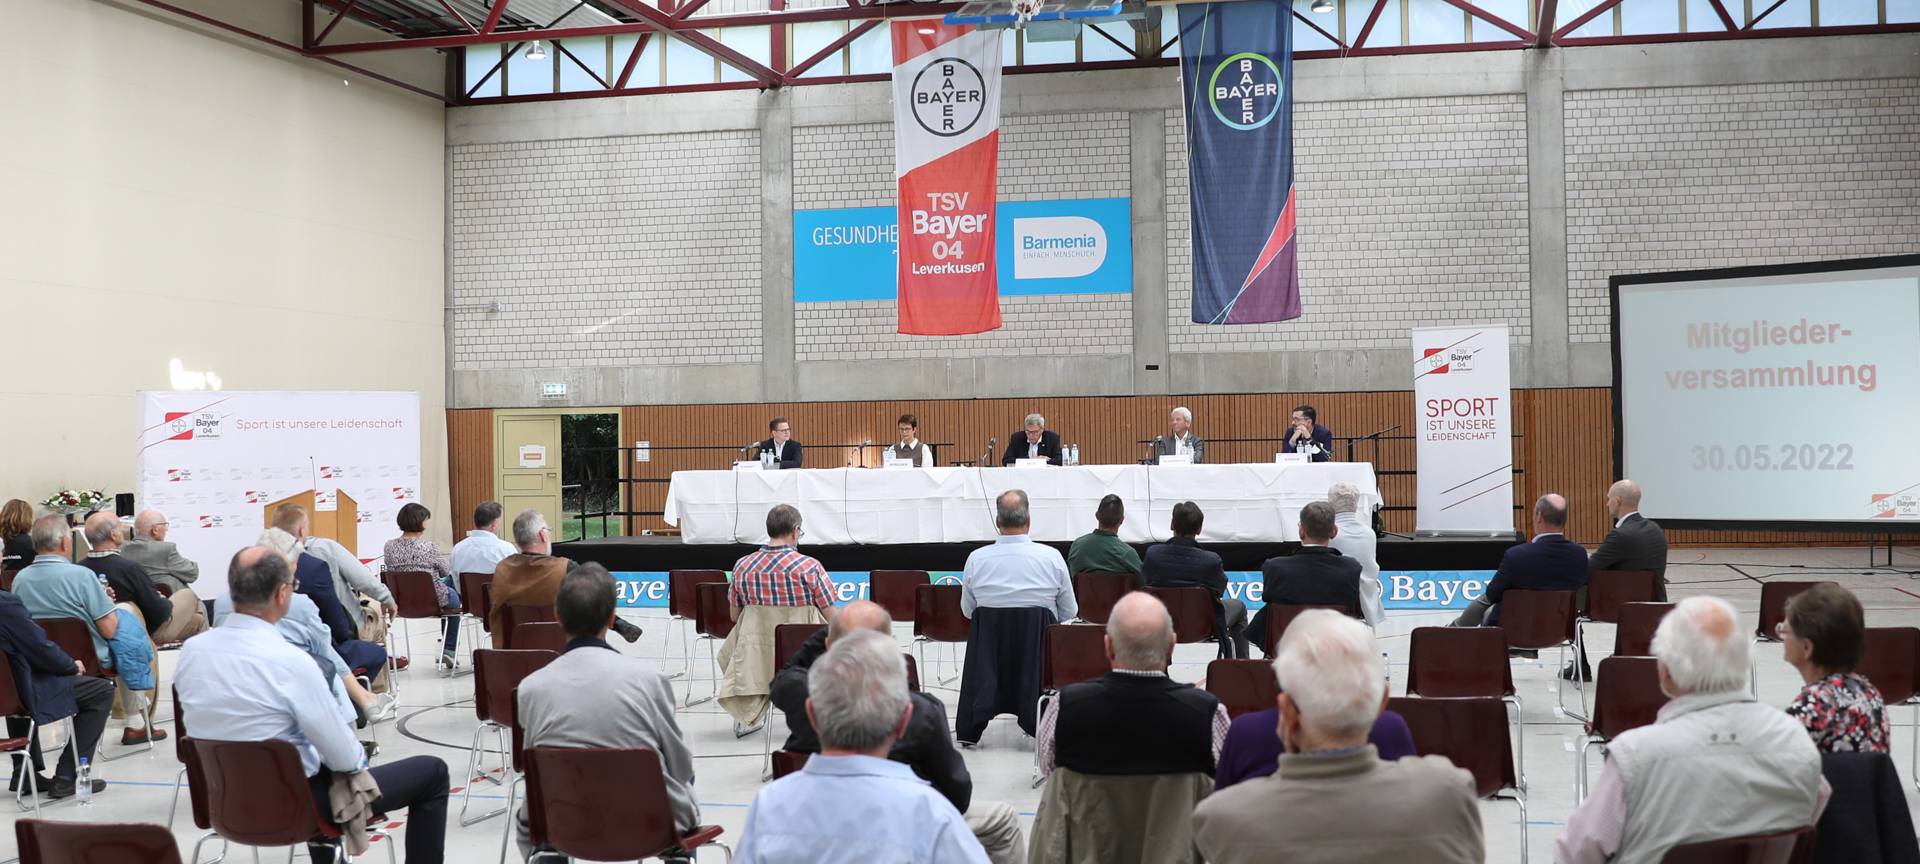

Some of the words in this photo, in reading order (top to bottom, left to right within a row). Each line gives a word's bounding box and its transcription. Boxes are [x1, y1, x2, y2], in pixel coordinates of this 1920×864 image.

[917, 90, 980, 104] BAYER
[943, 65, 954, 131] BAYER
[1215, 83, 1277, 100] BAYER
[1241, 59, 1255, 124] BAYER
[927, 191, 969, 212] TSV
[912, 210, 987, 239] Bayer
[932, 240, 964, 260] 04
[1023, 233, 1096, 250] Barmenia
[912, 262, 985, 275] Leverkusen
[1686, 318, 1853, 354] Mitglieder-
[1451, 353, 1472, 362] Bayer
[1664, 359, 1878, 392] versammlung
[1426, 397, 1499, 417] SPORT
[195, 418, 220, 428] Bayer
[236, 419, 268, 432] Sport
[272, 419, 286, 429] ist
[288, 420, 328, 429] unsere
[330, 418, 403, 429] Leidenschaft
[1426, 420, 1444, 430] IST
[1448, 419, 1496, 430] UNSERE
[1426, 432, 1497, 441] LEIDENSCHAFT
[1690, 443, 1854, 471] 30.05.2022
